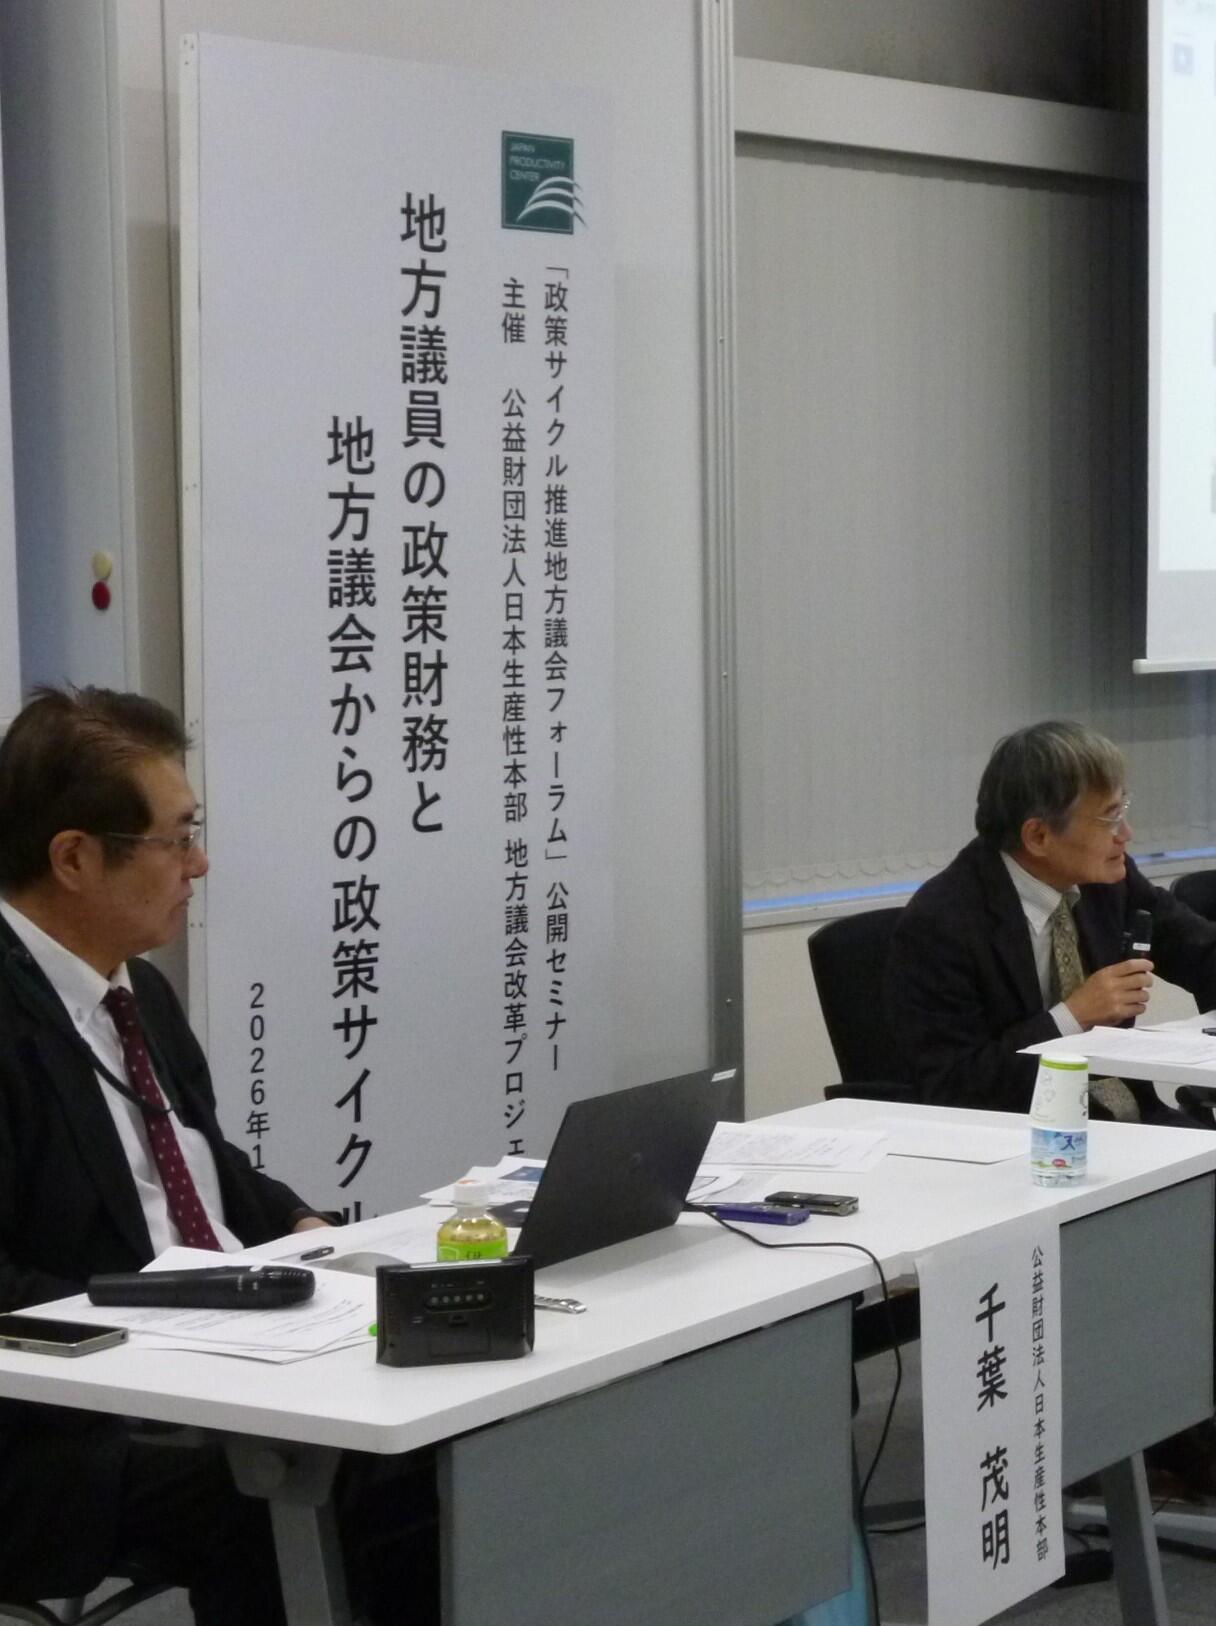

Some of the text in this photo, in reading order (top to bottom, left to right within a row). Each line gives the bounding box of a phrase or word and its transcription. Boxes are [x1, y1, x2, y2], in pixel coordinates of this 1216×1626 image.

[501, 276, 527, 344] 主催
[400, 192, 449, 834] 地方議員の政策財務と
[502, 388, 528, 824] 公益財団法人日本生産性本部
[974, 1282, 1011, 1571] 千葉 茂明
[1031, 1245, 1049, 1562] 公益財団法人日本生産性本部
